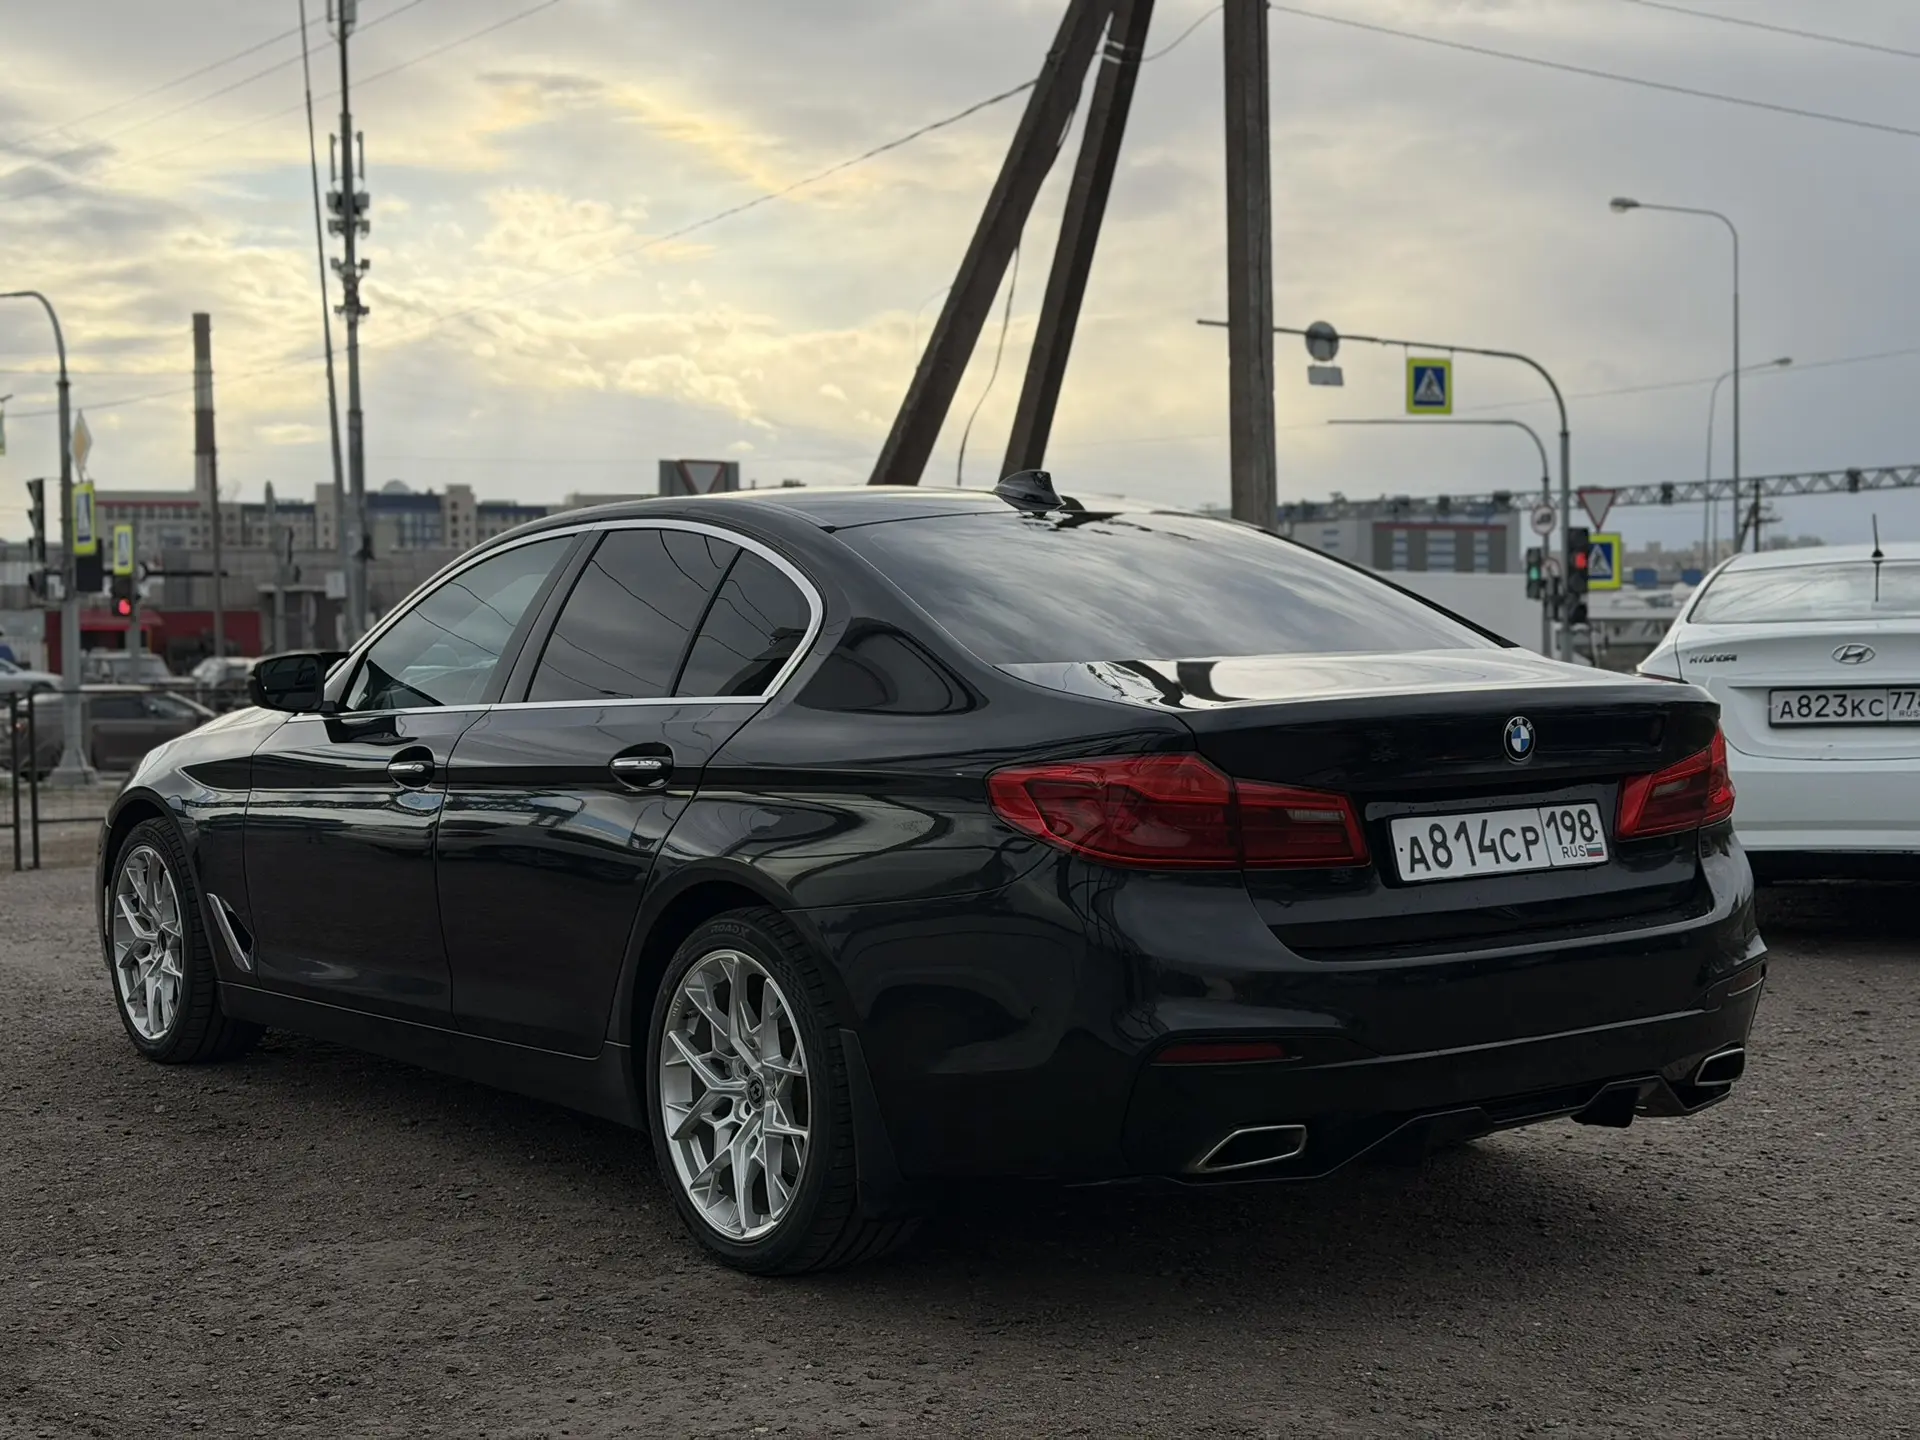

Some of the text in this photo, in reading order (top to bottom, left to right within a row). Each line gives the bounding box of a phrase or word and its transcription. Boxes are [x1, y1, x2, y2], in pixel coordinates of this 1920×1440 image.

[1890, 692, 1920, 710] 77
[1508, 717, 1533, 732] BMW
[1409, 808, 1595, 873] А814СР 198
[1561, 845, 1586, 859] RUS
